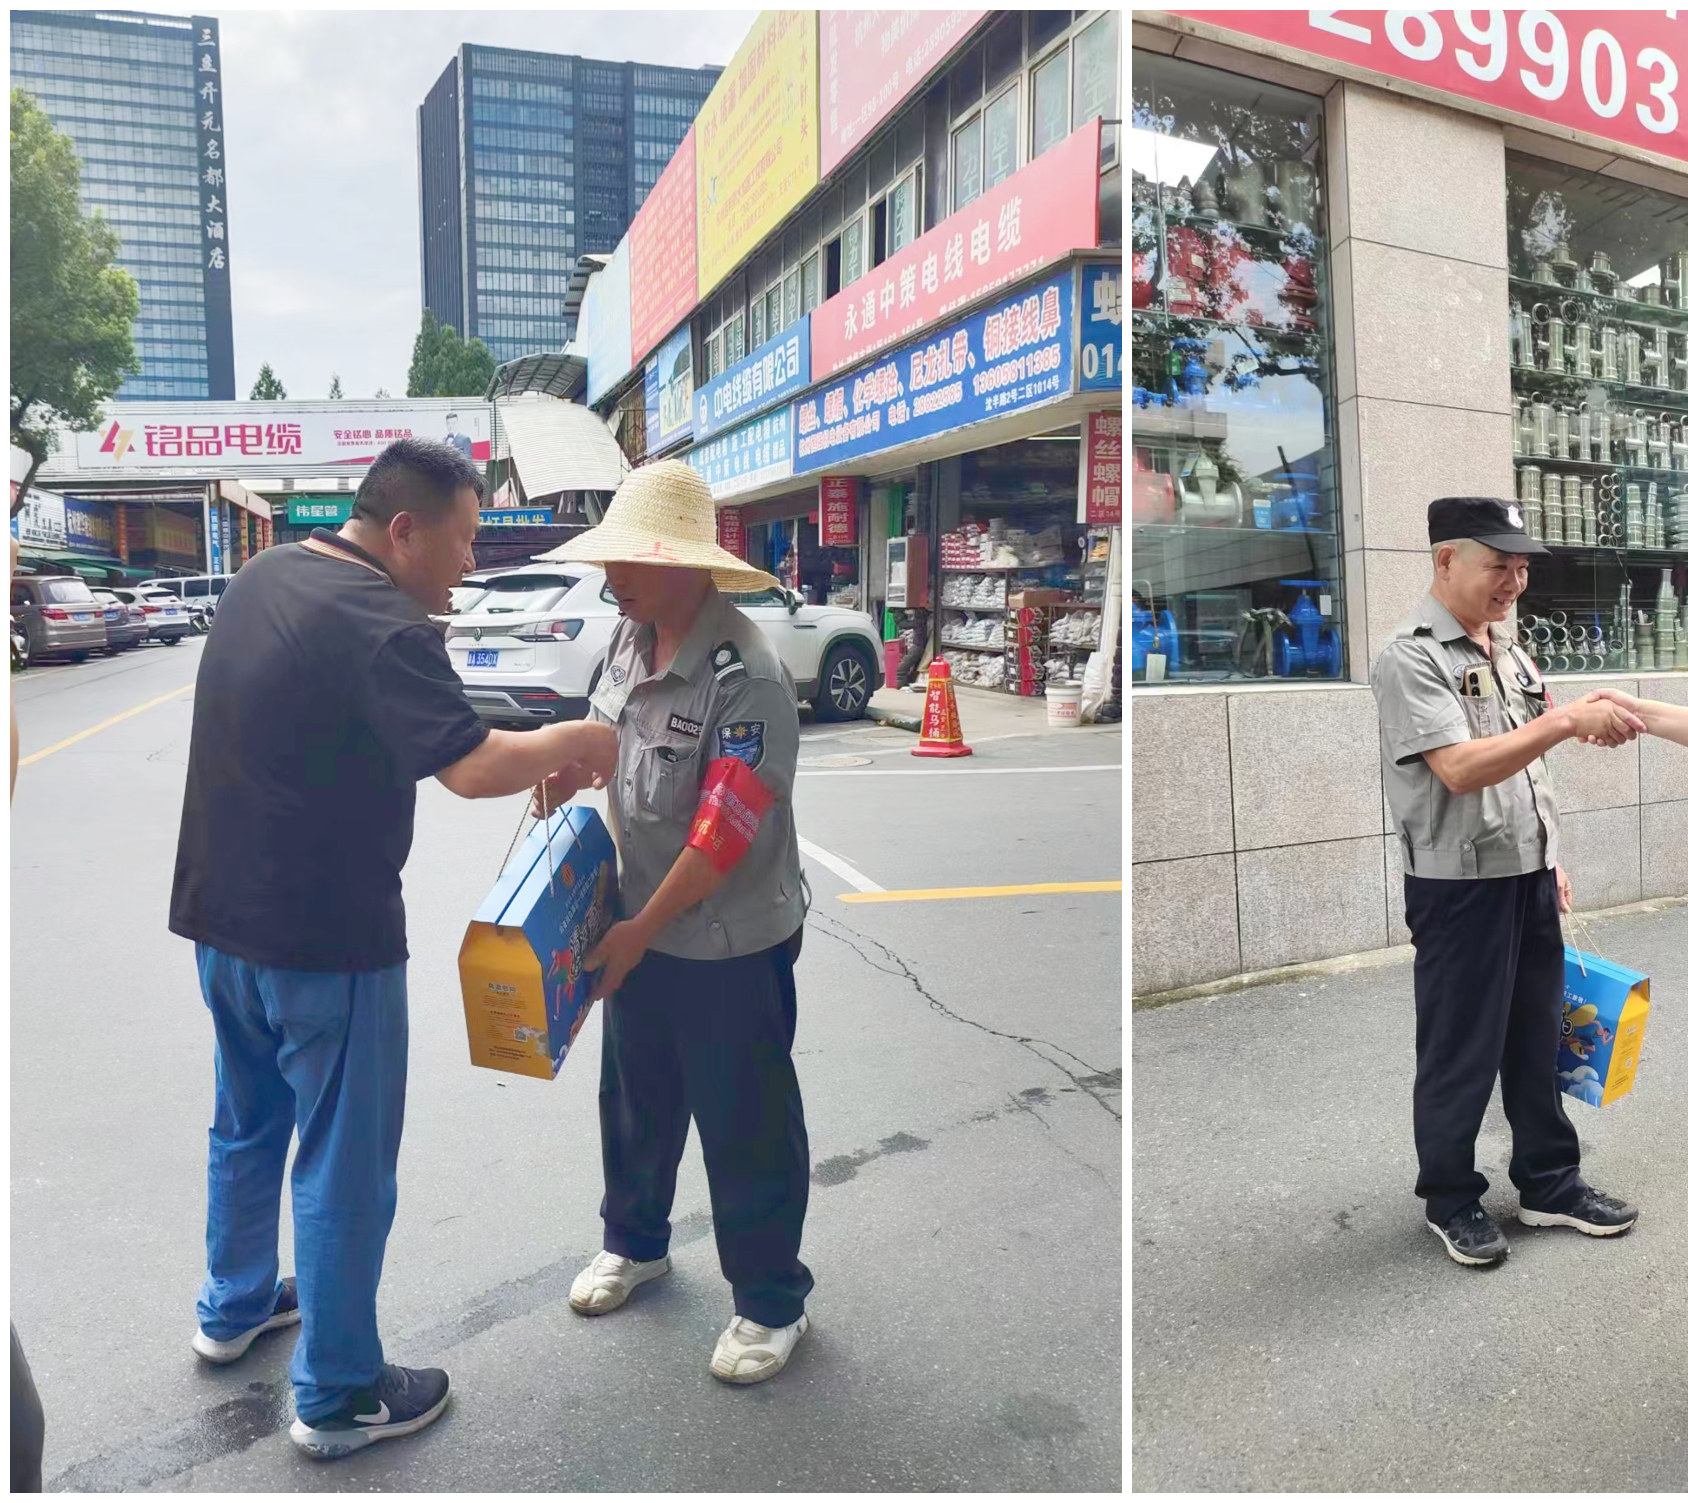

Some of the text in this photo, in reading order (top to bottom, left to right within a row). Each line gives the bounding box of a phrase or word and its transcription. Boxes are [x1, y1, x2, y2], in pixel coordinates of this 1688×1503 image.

[197, 28, 226, 269] 三立开元名都大酒店
[844, 195, 1023, 341] 永通中策电线电缆
[1082, 343, 1122, 379] 01
[145, 424, 303, 457] 铭品电缆
[1091, 415, 1122, 507] 螺丝螺帽
[295, 504, 339, 518] 伟星管
[929, 690, 941, 738] 智能马桶
